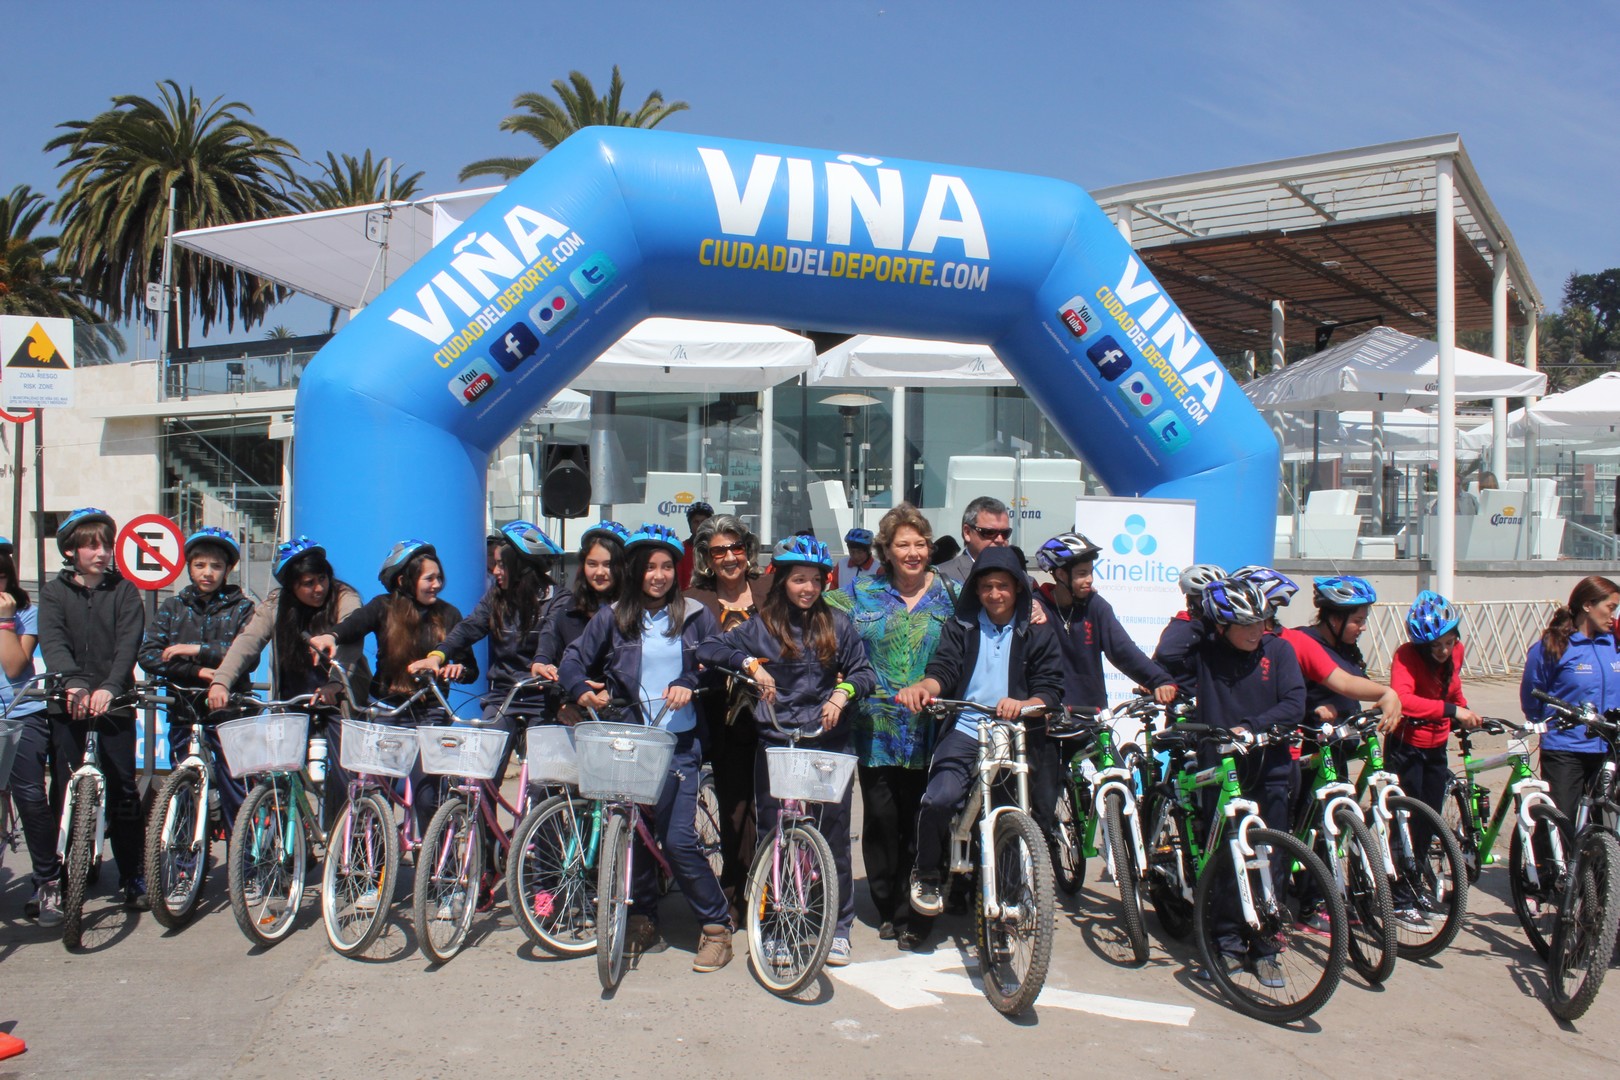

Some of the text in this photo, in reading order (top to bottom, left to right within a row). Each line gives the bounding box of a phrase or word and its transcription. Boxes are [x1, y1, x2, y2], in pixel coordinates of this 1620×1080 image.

[697, 147, 990, 260] VIÑA
[387, 205, 570, 345] VIÑA
[699, 238, 990, 292] CIUDADDELDEPORTE.COM
[433, 231, 585, 369] CIUDADDELDEPORTE.COM
[1077, 304, 1092, 323] You
[1065, 312, 1083, 332] Tube
[1114, 254, 1224, 413] VIÑA
[1095, 285, 1209, 426] CIUDADDELDEPORTE.COM
[458, 368, 478, 385] You
[466, 378, 488, 398] Tube
[658, 500, 691, 517] Coro
[1490, 513, 1523, 526] Corona
[137, 532, 164, 571] E
